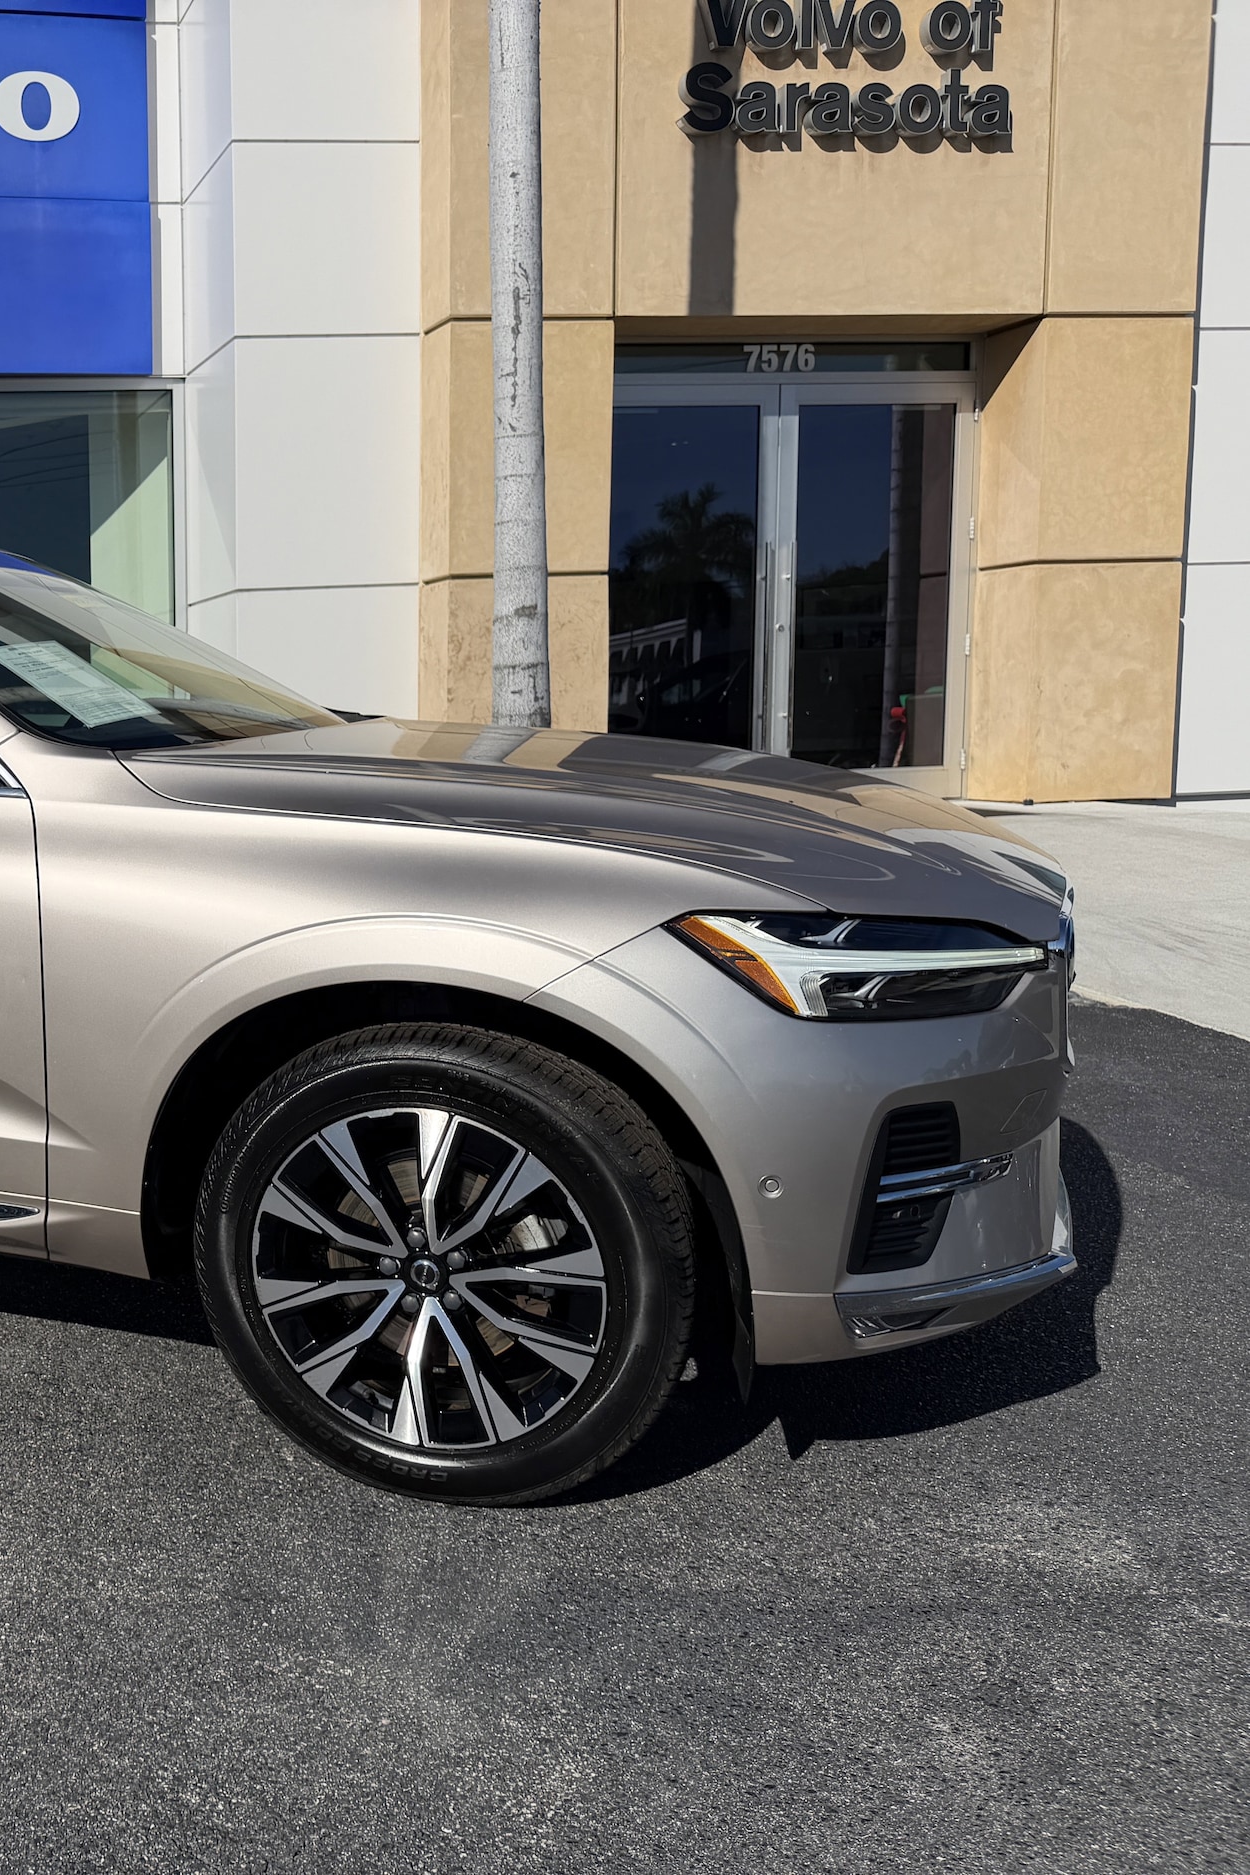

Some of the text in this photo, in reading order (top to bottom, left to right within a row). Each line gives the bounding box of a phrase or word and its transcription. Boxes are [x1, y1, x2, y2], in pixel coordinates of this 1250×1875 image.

[703, 0, 1001, 52] Volvo of
[678, 62, 1011, 135] Sarasota
[742, 343, 816, 373] 7576
